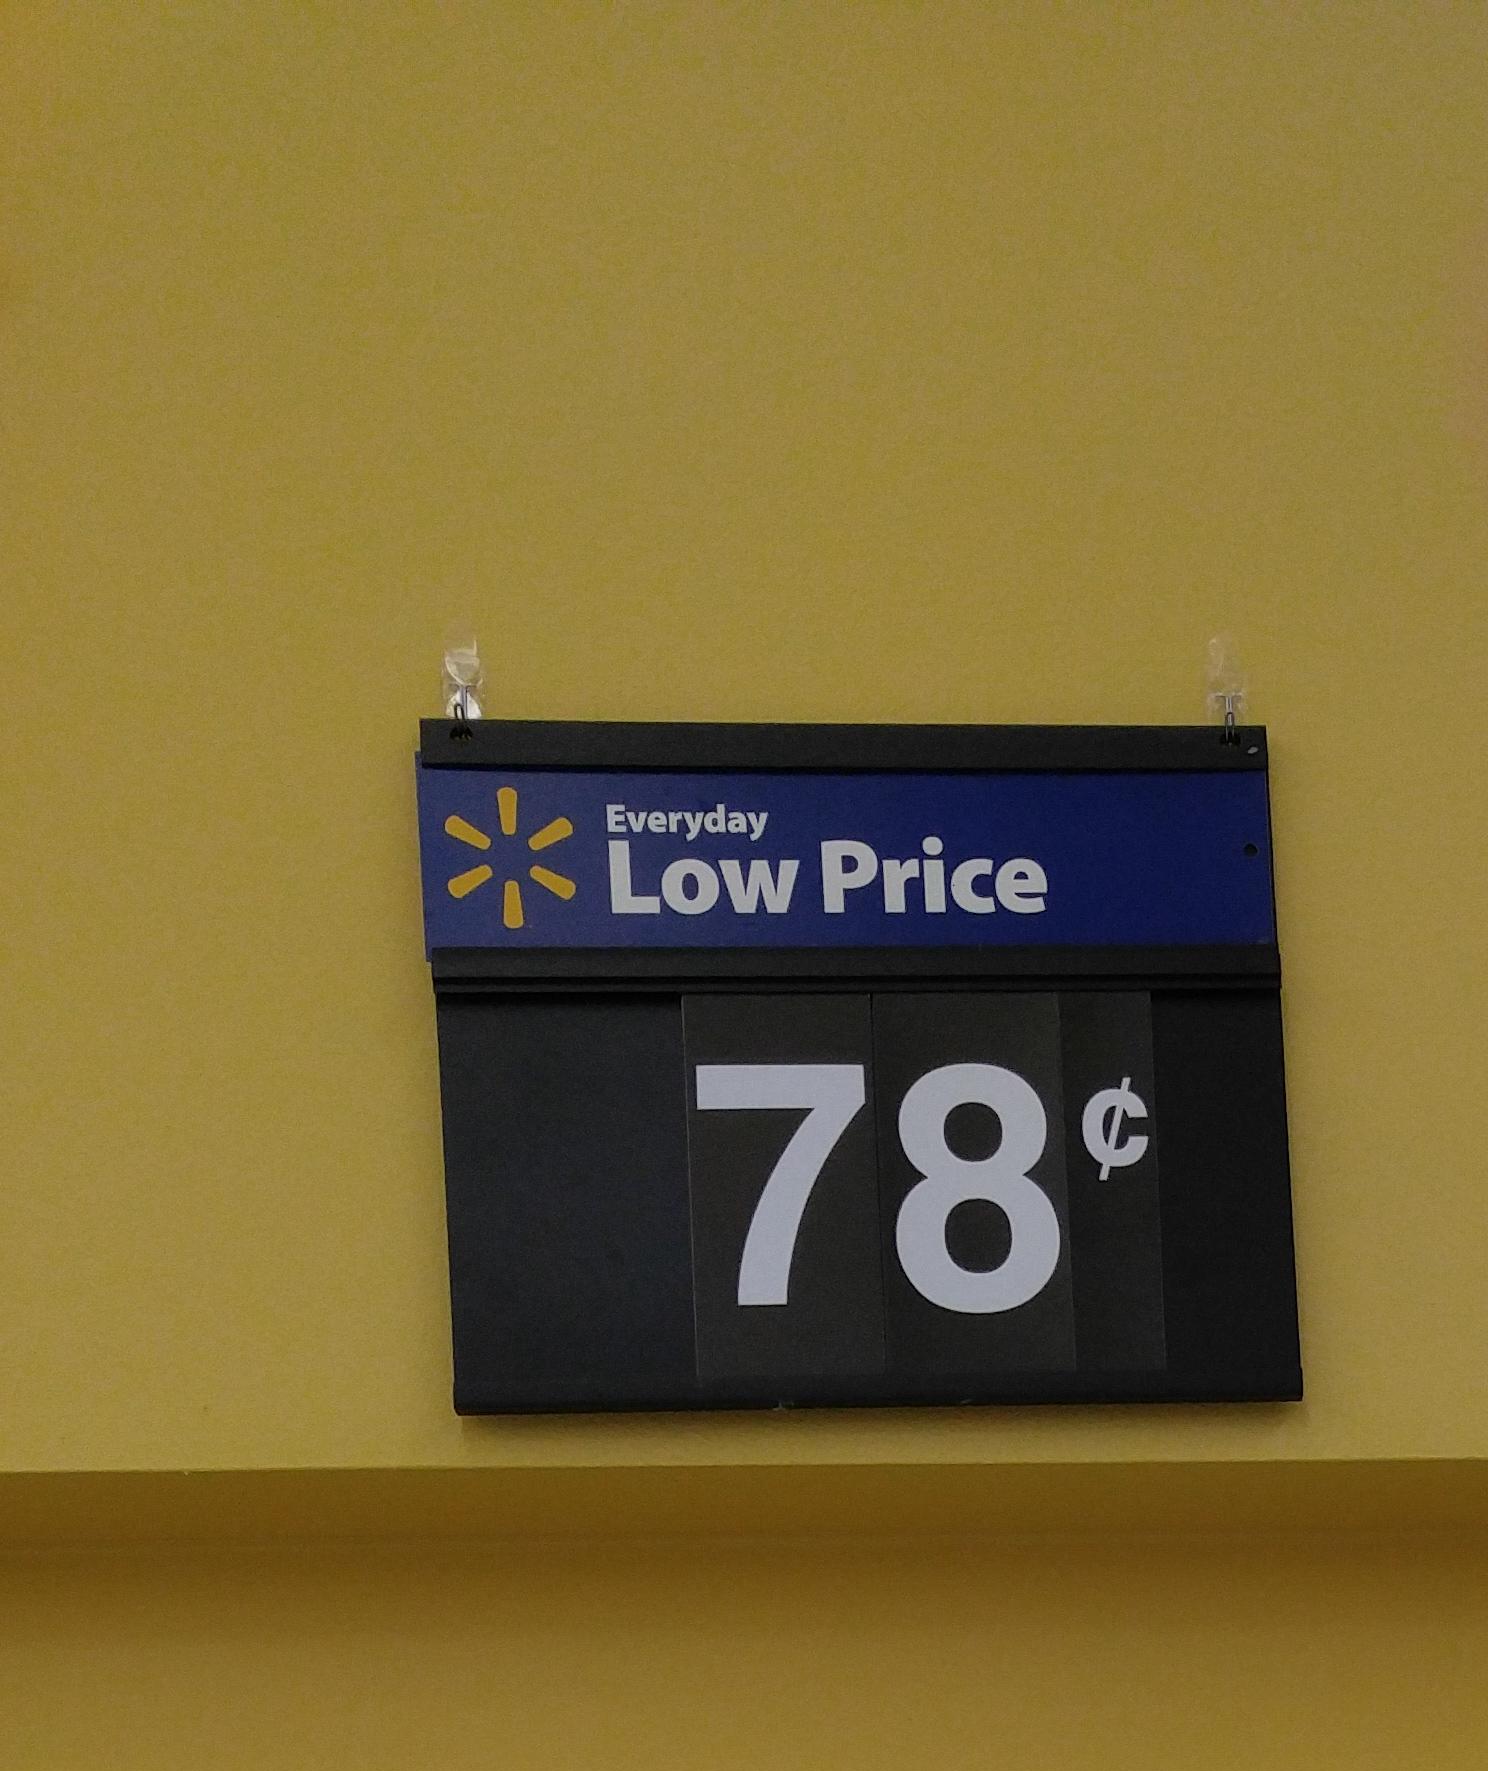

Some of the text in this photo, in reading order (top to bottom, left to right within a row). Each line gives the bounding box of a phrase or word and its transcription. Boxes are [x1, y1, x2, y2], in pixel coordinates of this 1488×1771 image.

[604, 804, 769, 842] Everyday
[606, 836, 1050, 916] Low Price
